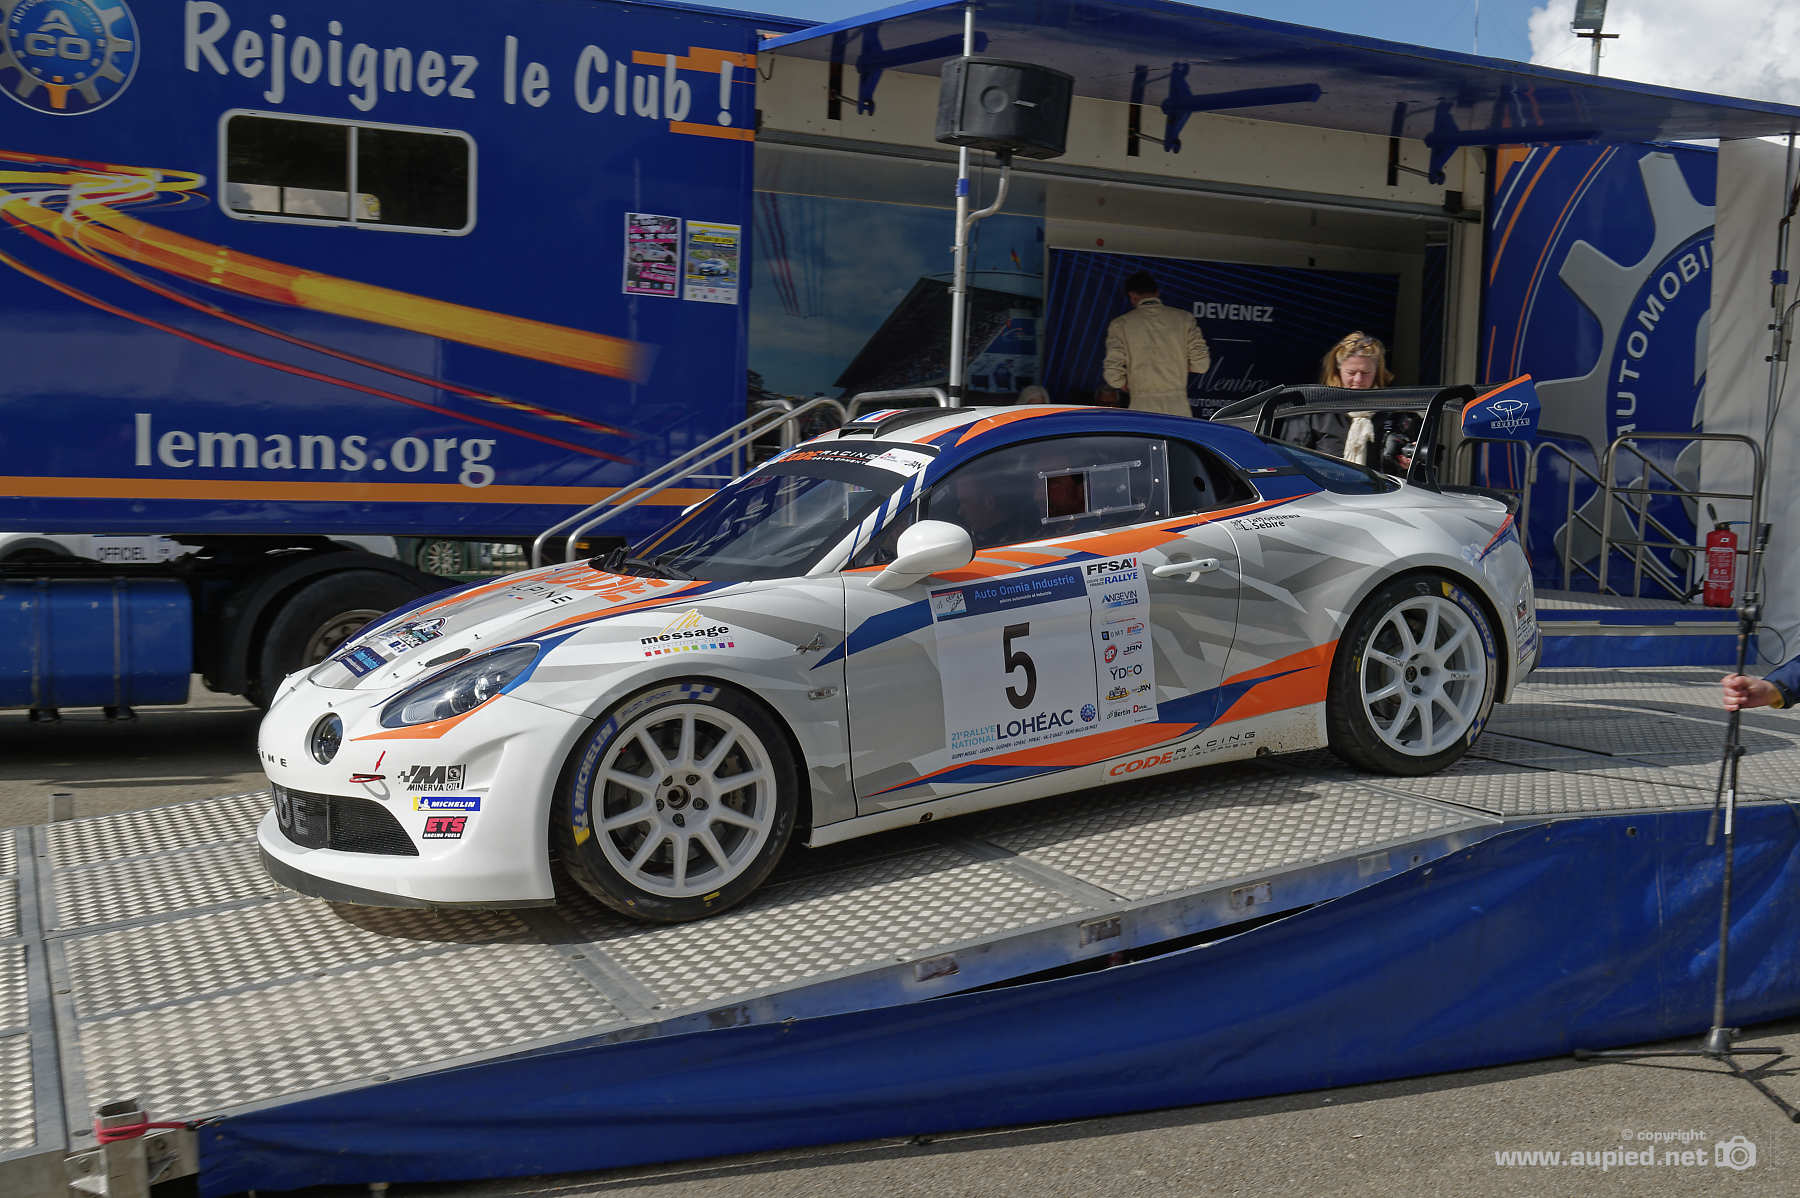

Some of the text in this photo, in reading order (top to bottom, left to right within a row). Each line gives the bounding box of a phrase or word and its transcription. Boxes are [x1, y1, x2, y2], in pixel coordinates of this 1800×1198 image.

[185, 0, 733, 127] Rejoignez le Club !
[1193, 302, 1274, 322] DEVENEZ
[134, 413, 496, 487] lemans.org
[1087, 558, 1133, 576] FFSA
[974, 589, 997, 601] Auto
[1000, 584, 1031, 597] Omnia
[1032, 575, 1076, 591] Industrie
[1105, 572, 1138, 585] RALLYE
[1102, 590, 1138, 603] ANGEVIN
[640, 624, 730, 645] message
[1002, 621, 1038, 710] 5
[996, 709, 1074, 740] LOHÉAC
[951, 735, 996, 750] NATIONAL
[1109, 731, 1256, 777] CODE RACING
[573, 723, 613, 808] MICHELIN
[407, 783, 444, 792] MINERVA
[430, 800, 476, 808] MICHELIN
[427, 818, 466, 833] ETS
